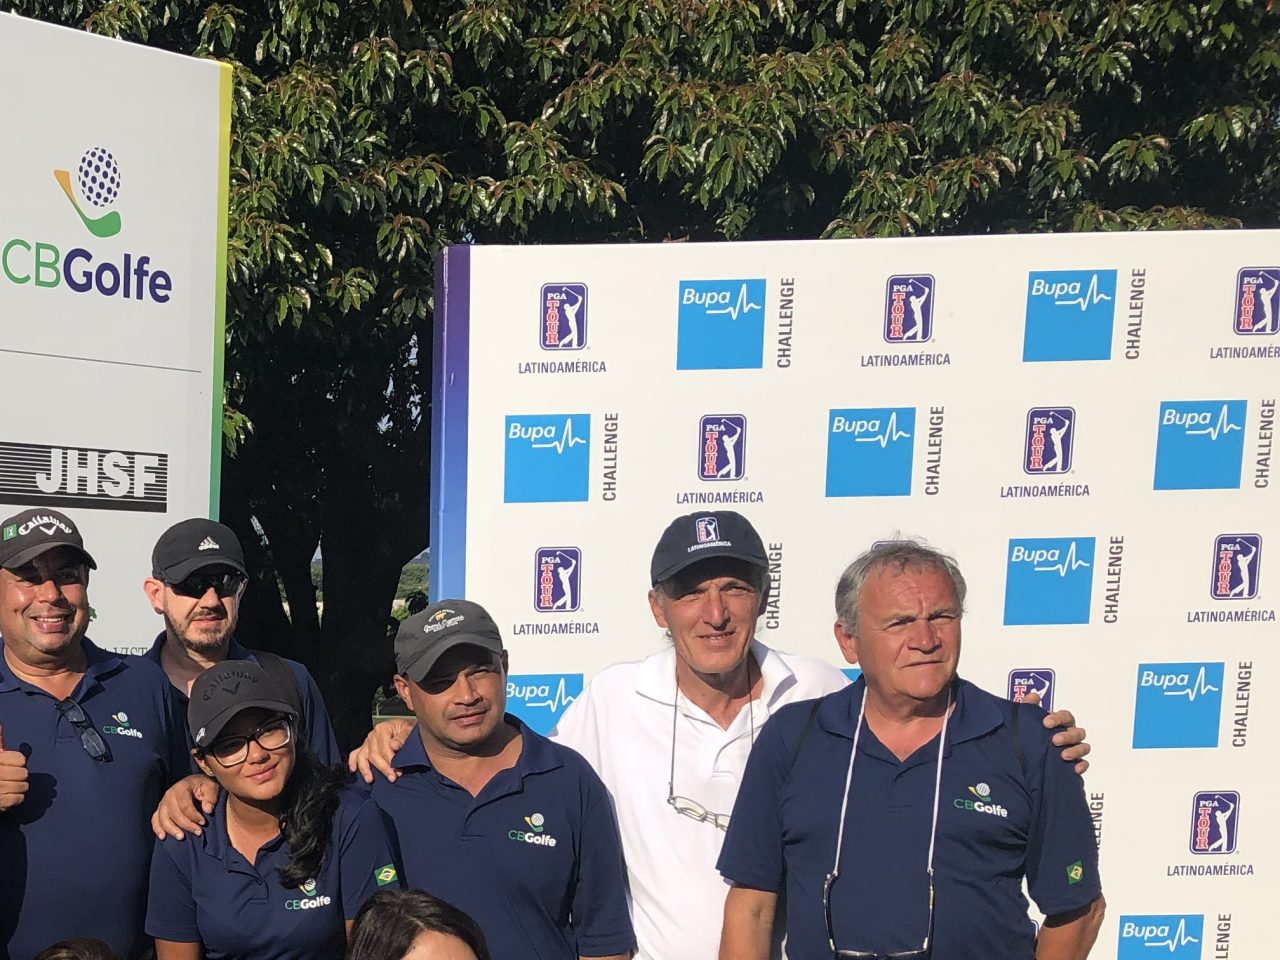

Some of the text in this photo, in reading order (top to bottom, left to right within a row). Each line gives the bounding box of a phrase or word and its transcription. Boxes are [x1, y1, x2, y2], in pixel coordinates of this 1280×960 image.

[2, 238, 172, 304] CBGolfe
[1243, 276, 1264, 284] PGA
[683, 289, 730, 306] Bupa
[893, 284, 913, 292] PGA
[1032, 280, 1080, 299] Bupa
[890, 293, 905, 337] TOUR
[1126, 269, 1145, 359] CHALLENGE
[1240, 285, 1256, 329] TOUR
[546, 301, 558, 344] TOUR
[777, 278, 794, 368] CHALLENGE
[519, 359, 606, 373] LATINOAMÉRICA
[861, 351, 950, 367] LATINOAMÉRICA
[833, 417, 880, 436] Bupa
[1034, 416, 1054, 424] PGA
[1163, 409, 1211, 428] Bupa
[509, 424, 555, 441] Bupa
[704, 432, 718, 475] TOUR
[925, 407, 944, 495] CHALLENGE
[1030, 425, 1045, 469] TOUR
[1255, 400, 1275, 488] CHALLENGE
[603, 413, 618, 501] CHALLENGE
[36, 448, 161, 498] JHSF
[677, 489, 763, 504] LATINOAMÉRICA
[1001, 483, 1089, 497] LATINOAMÉRICA
[18, 515, 72, 535] Callaway
[687, 541, 732, 552] LATINOAMÉRICA
[542, 556, 560, 564] PGA
[1012, 547, 1060, 566] Bupa
[1104, 536, 1123, 623] CHALLENGE
[1218, 551, 1233, 595] TOUR
[540, 564, 553, 607] TOUR
[766, 543, 782, 629] CHALLENGE
[1188, 608, 1275, 622] LATINOAMÉRICA
[514, 623, 599, 635] LATINOAMÉRICA
[1014, 677, 1034, 685] PGA
[1141, 672, 1188, 690] Bupa
[507, 682, 550, 703] Bupa
[1233, 662, 1252, 747] CHALLENGE
[102, 725, 143, 739] CBGolfe
[954, 799, 1008, 818] CBGolfe
[1196, 808, 1211, 849] TOUR
[508, 830, 556, 847] CBGolfe
[1167, 862, 1253, 876] LATINOAMÉRICA
[285, 895, 331, 910] CBGolfe
[1122, 923, 1168, 941] Bupa
